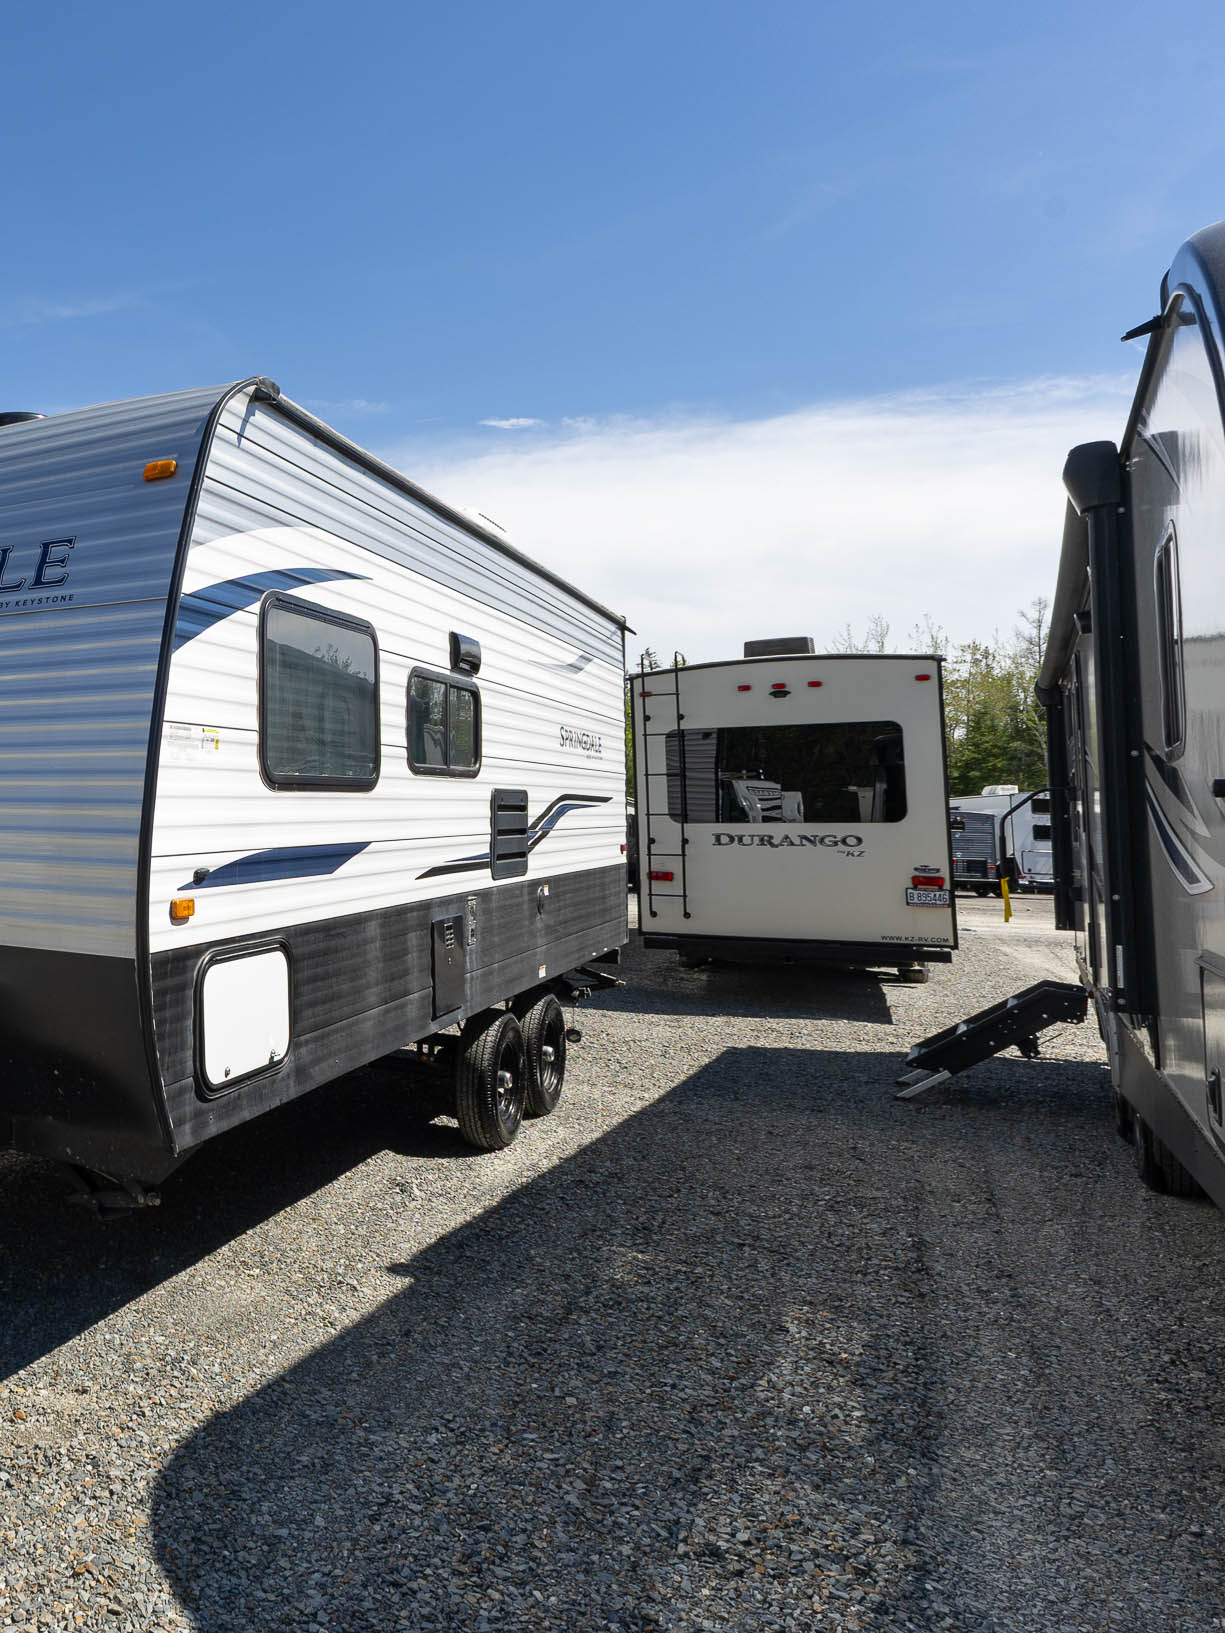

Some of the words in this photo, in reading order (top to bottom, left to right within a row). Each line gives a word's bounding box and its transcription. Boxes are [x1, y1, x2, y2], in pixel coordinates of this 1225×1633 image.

[14, 594, 75, 608] KEYSTONE
[559, 726, 602, 753] SPRINGDALE
[712, 832, 864, 848] DURANGO
[845, 850, 865, 858] KZ
[881, 935, 949, 943] WWW.KZ-RV.COM
